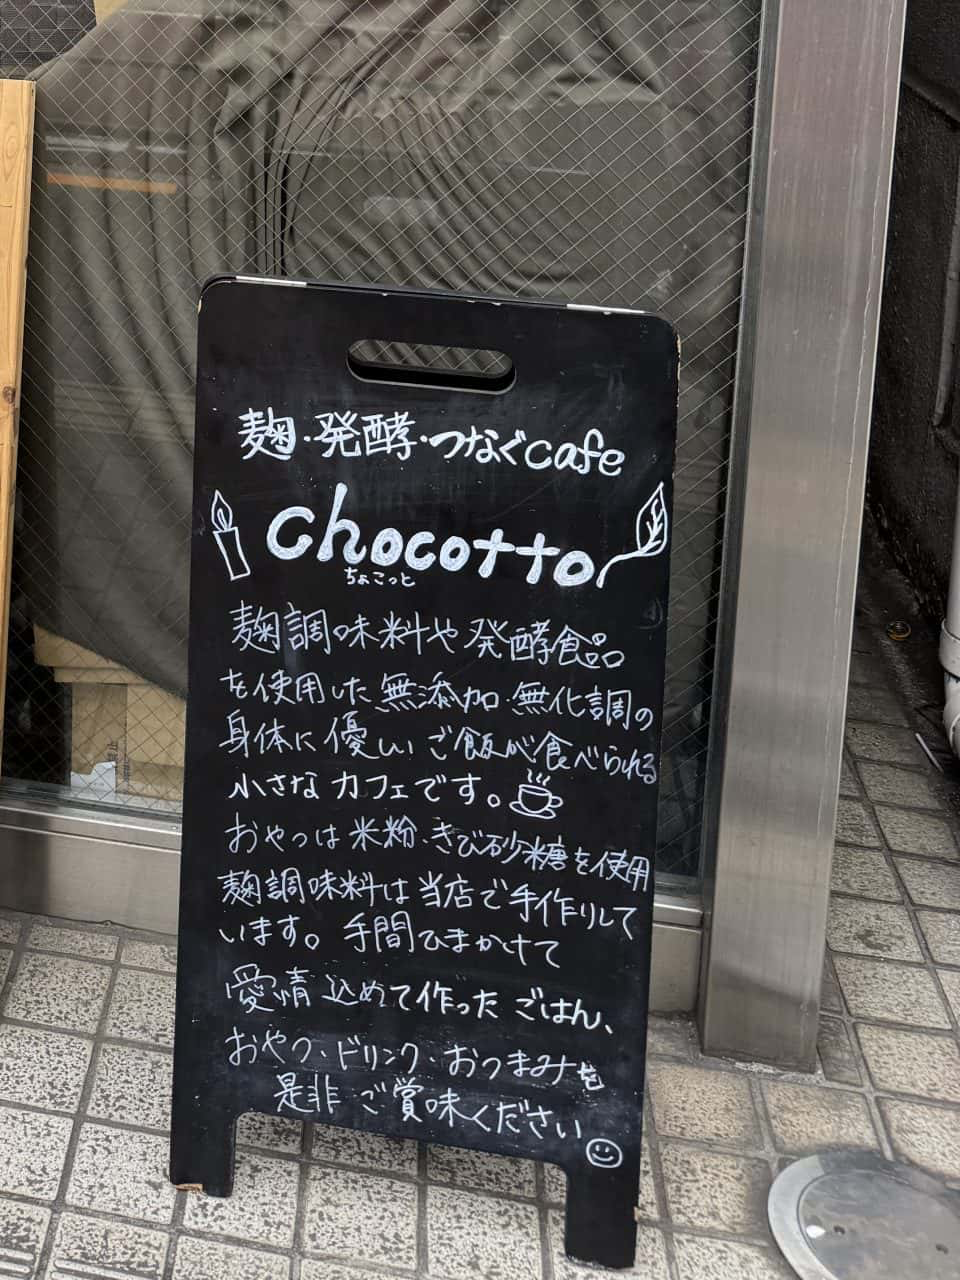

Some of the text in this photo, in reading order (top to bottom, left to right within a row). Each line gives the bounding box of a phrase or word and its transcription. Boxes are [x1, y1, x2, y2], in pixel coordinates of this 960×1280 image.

[343, 566, 417, 587] ちょこっと
[228, 600, 626, 669] 麹調味料や発酵食品
[218, 709, 658, 785] 身体に優しいご飯が食べられる
[227, 771, 501, 809] 小さなカフェです。
[217, 866, 639, 942] 麹調味料は当店で手作りして
[225, 963, 614, 1036] 愛情込めて作ったごはん、
[273, 1070, 583, 1140] 是非ご賞味ください
